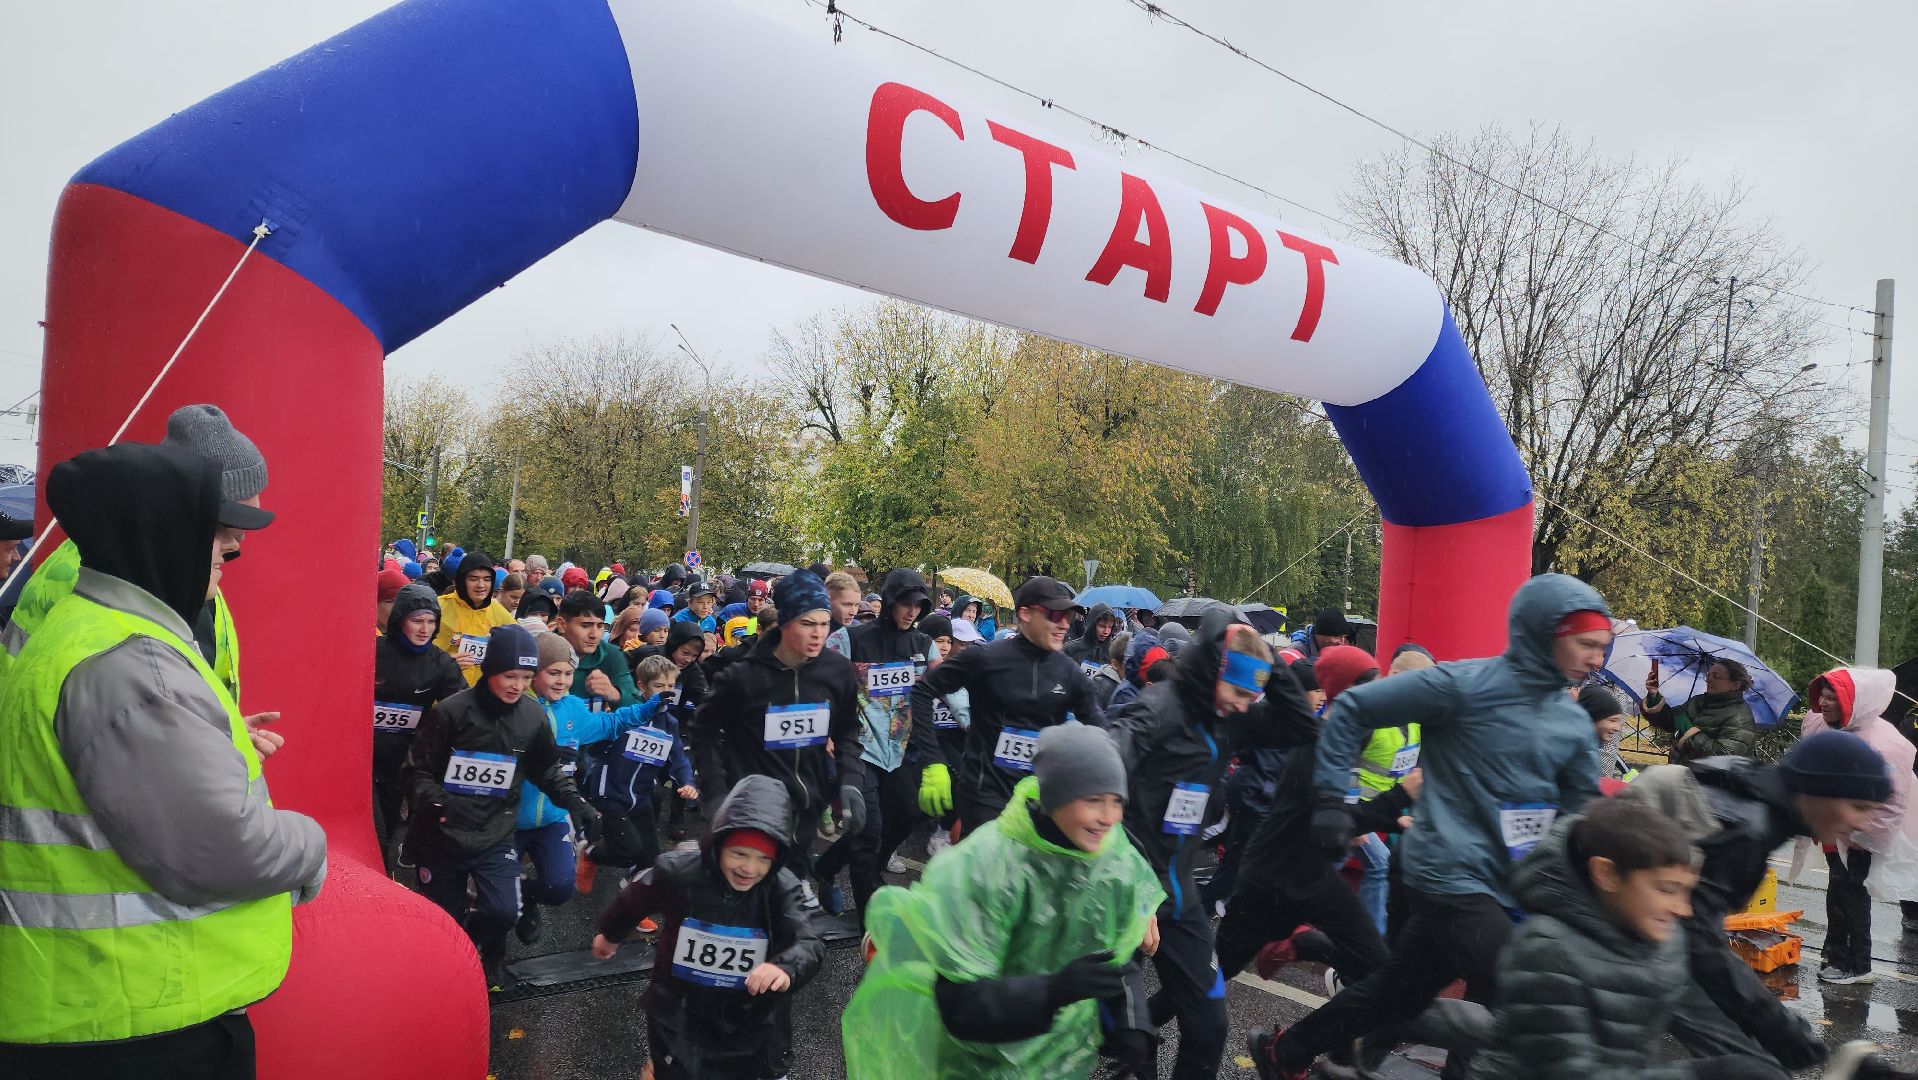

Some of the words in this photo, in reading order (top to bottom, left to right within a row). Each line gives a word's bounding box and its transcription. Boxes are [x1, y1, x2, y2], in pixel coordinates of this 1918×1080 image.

[865, 81, 1340, 343] СТАРТ
[872, 670, 910, 687] 1568
[374, 711, 410, 727] 935
[780, 718, 815, 737] 951
[631, 737, 664, 757] 1291
[451, 764, 507, 785] 1865
[683, 938, 756, 973] 1825
